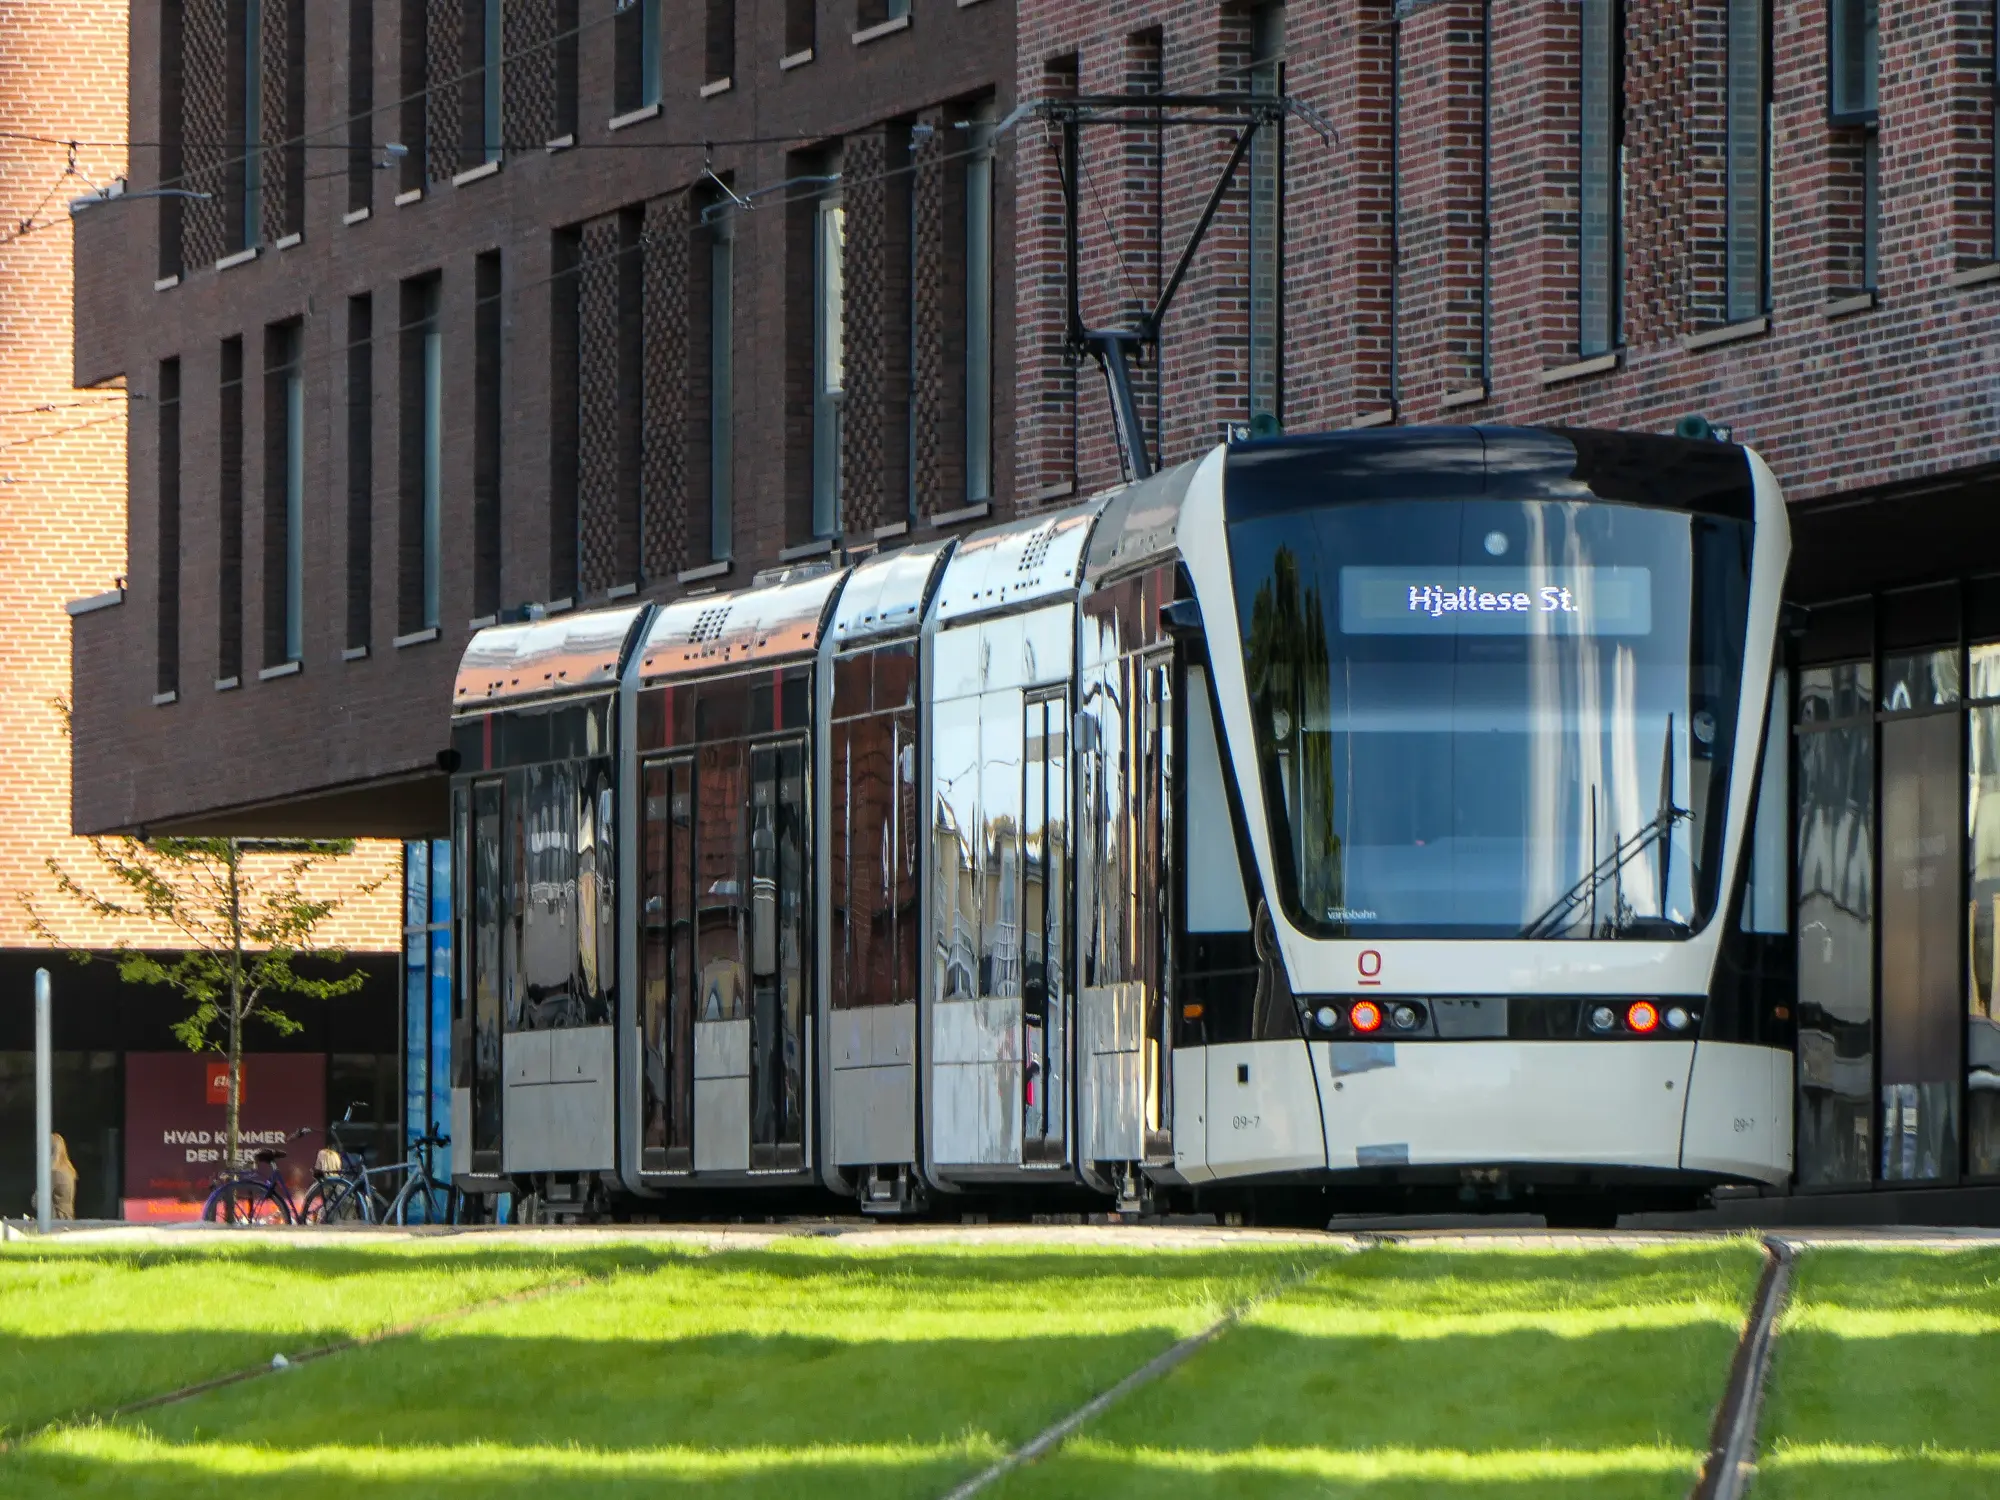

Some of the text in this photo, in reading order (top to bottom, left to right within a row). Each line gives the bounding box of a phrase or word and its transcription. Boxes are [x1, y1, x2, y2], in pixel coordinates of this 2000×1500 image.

[1409, 585, 1578, 617] Hjallese St.
[1232, 1115, 1260, 1130] 09-7
[163, 1130, 287, 1145] HVAD KMMER
[185, 1148, 220, 1163] DER
